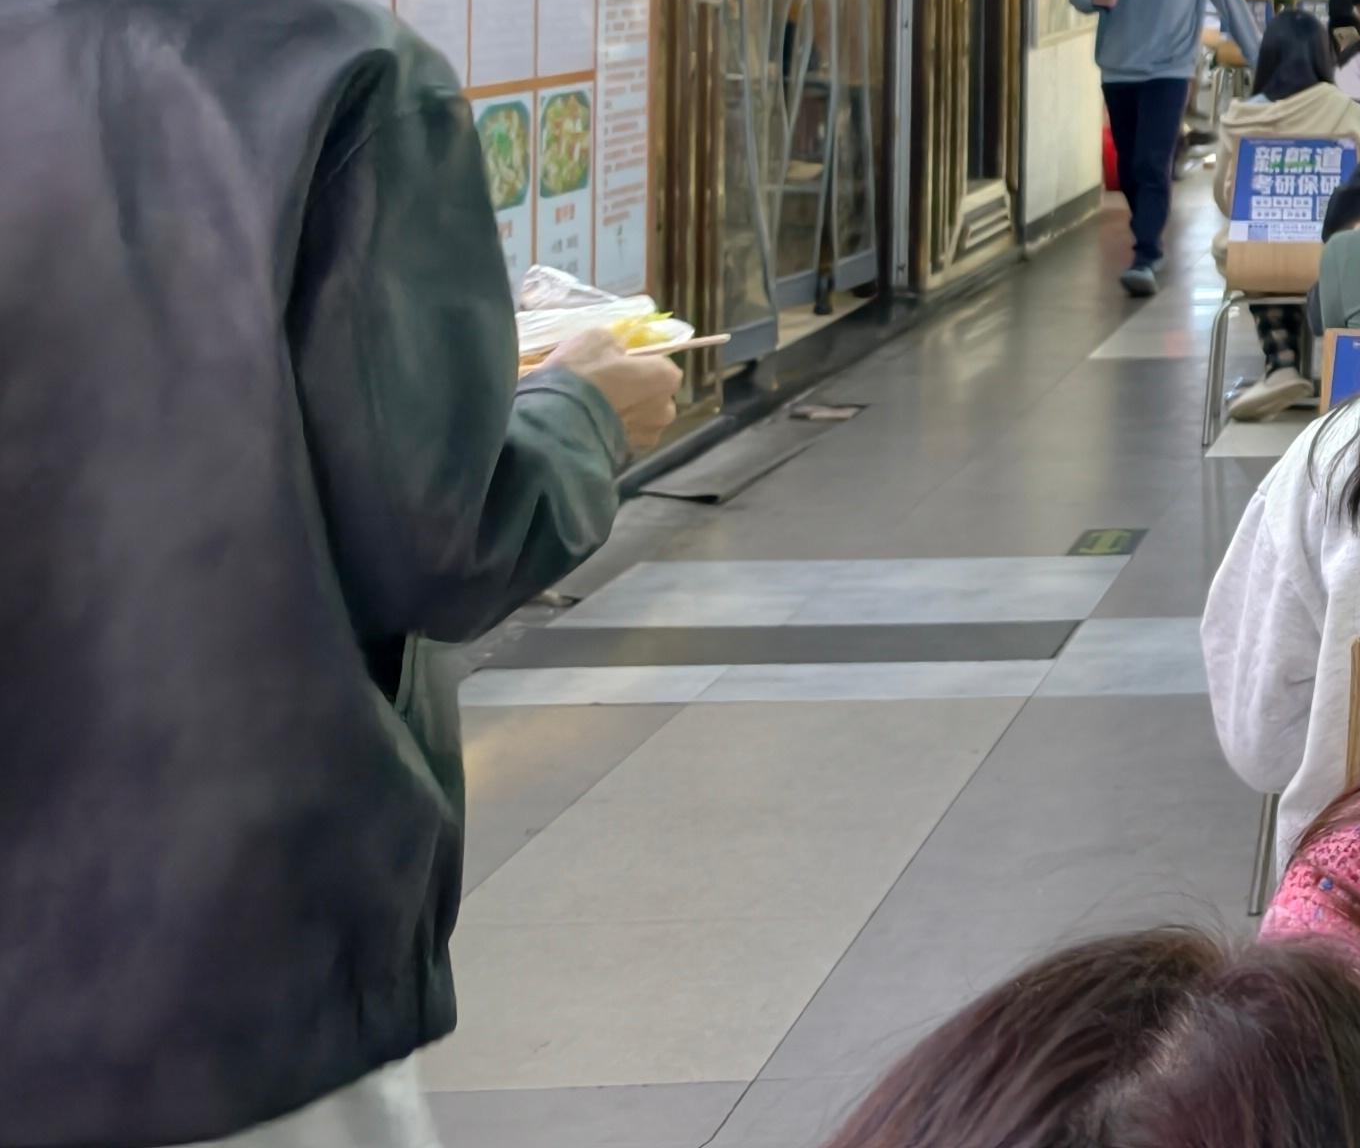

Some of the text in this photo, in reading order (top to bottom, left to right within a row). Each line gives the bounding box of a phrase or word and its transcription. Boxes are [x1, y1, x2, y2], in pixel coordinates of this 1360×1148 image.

[1253, 146, 1343, 173] 新航道
[1252, 174, 1341, 195] 考研保研
